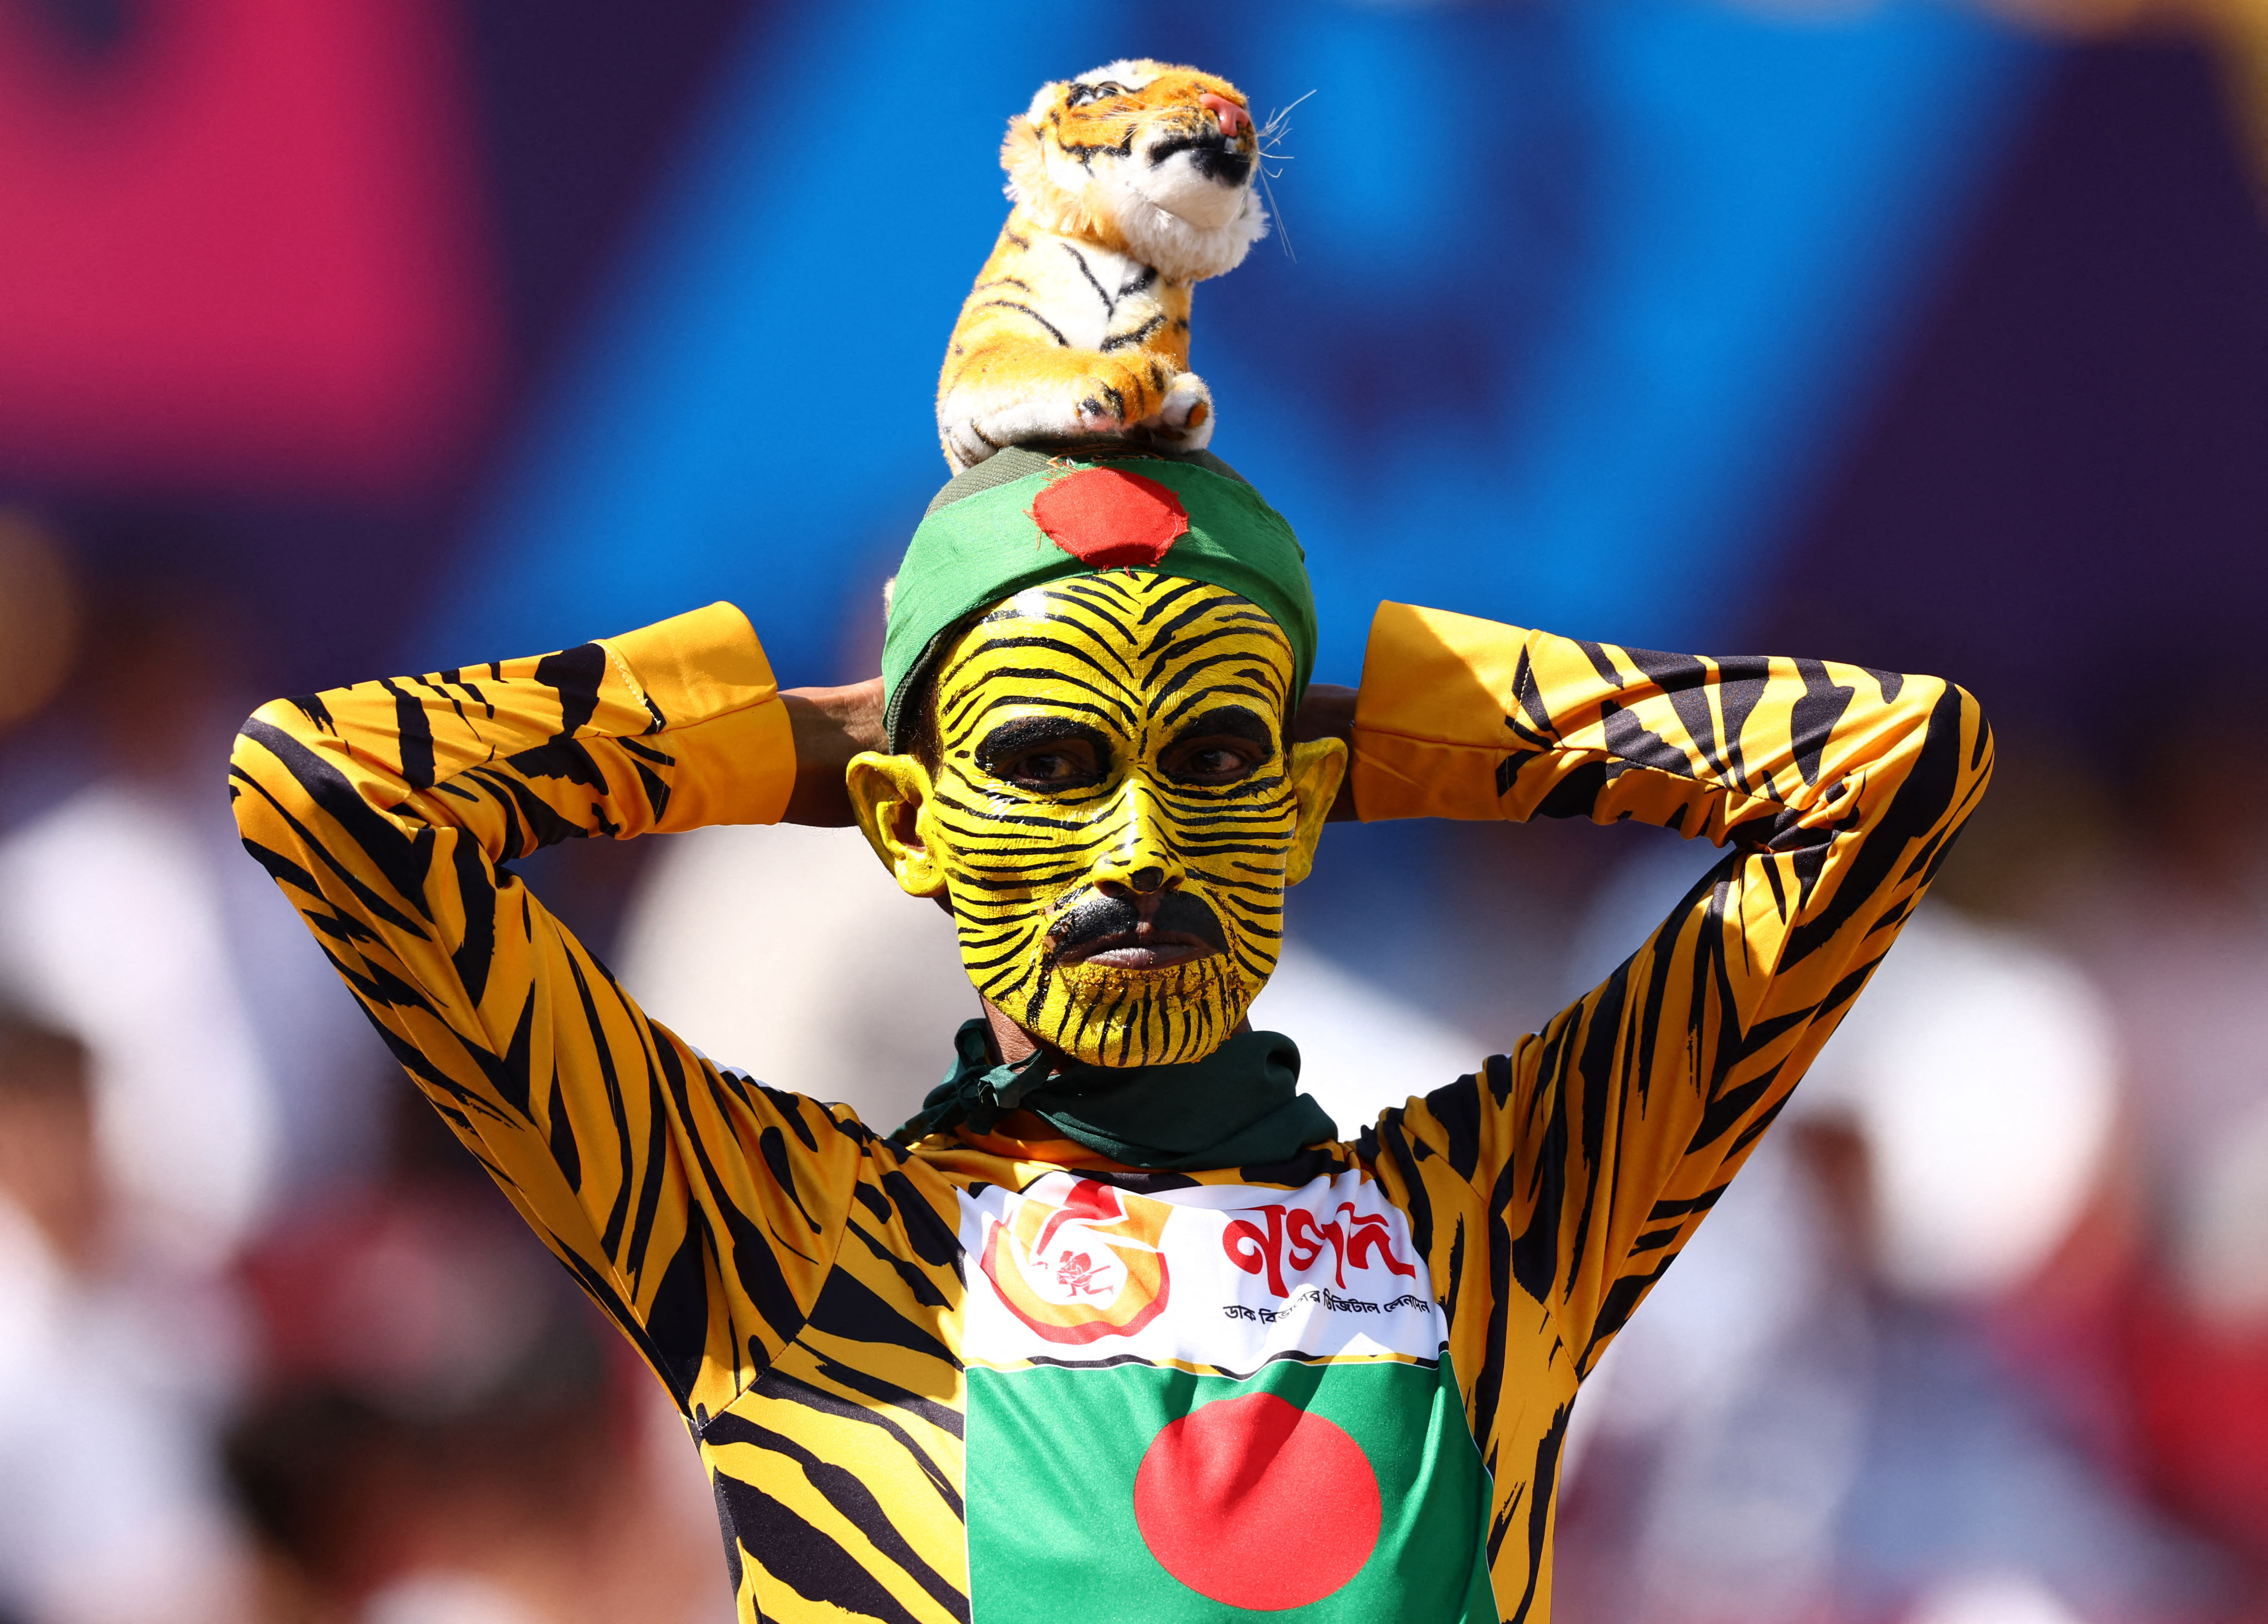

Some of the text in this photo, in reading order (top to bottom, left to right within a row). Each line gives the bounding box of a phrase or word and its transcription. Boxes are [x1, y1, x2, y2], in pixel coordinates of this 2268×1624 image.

[1222, 1201, 1416, 1299] নগদ
[1223, 1305, 1257, 1322] ডাক
[1258, 1290, 1321, 1324] বিভগর
[1323, 1288, 1380, 1314] ডিজিটাল
